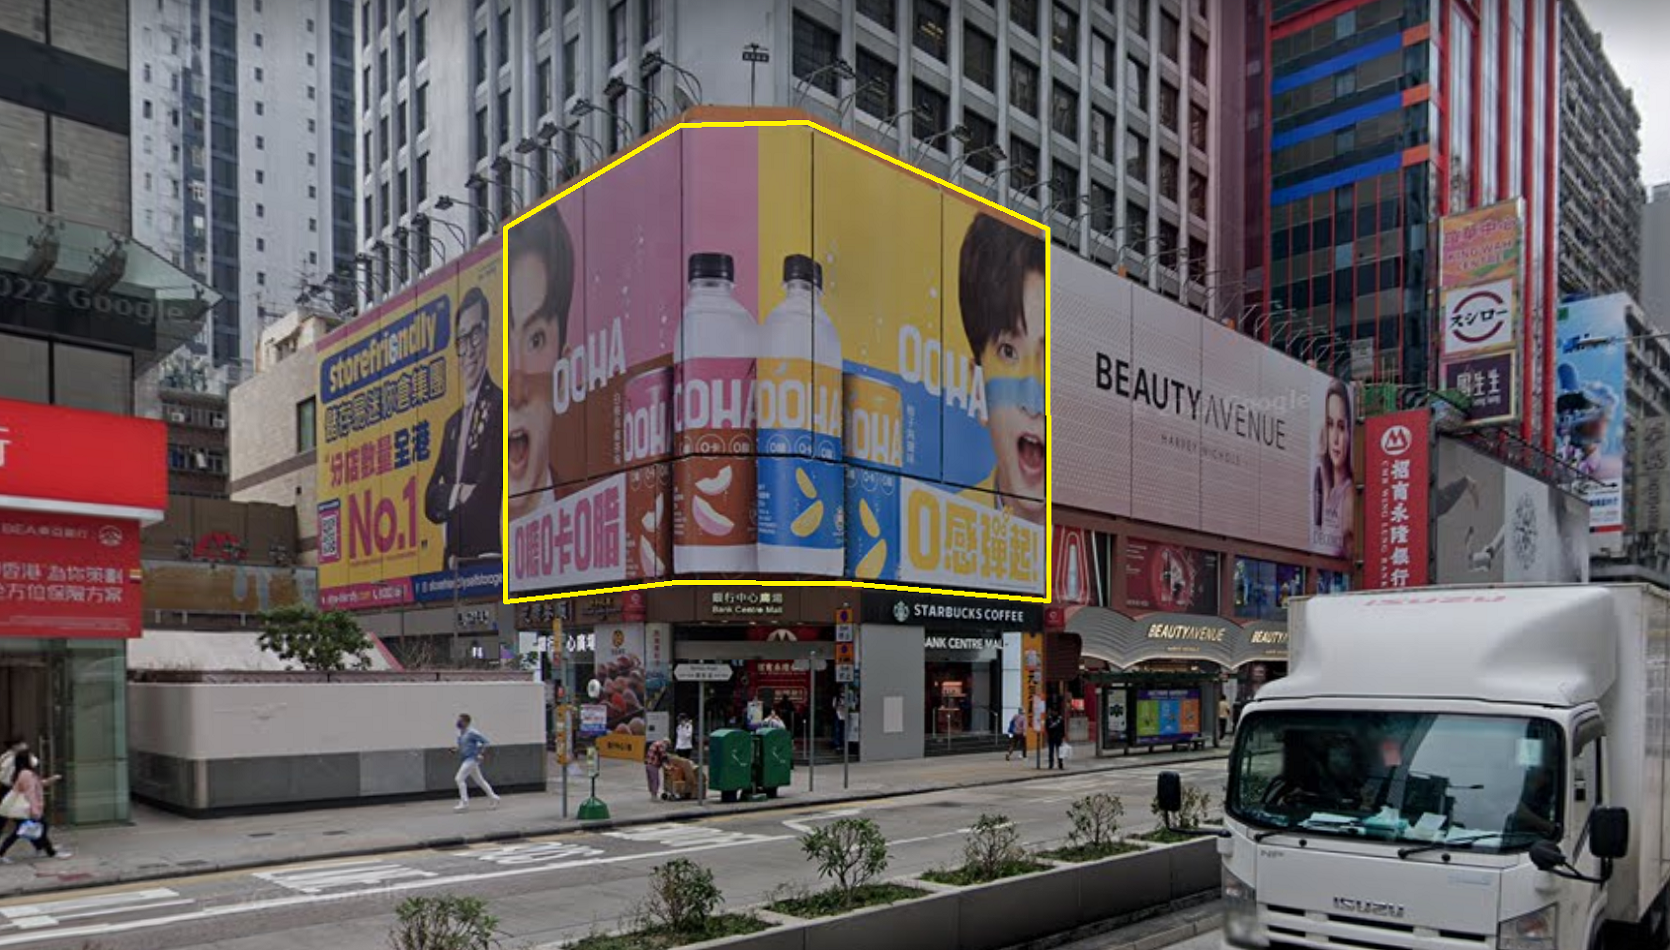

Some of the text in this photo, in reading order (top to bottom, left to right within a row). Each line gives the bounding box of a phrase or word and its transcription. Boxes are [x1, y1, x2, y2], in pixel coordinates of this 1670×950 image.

[1450, 307, 1508, 328] スシロー
[329, 311, 437, 394] storefriendly
[553, 317, 627, 415] OOHA
[900, 324, 988, 421] OOHA
[1390, 459, 1410, 587] 招商永隆銀行
[712, 592, 783, 604] 銀行中心廣場
[712, 605, 783, 614] Bank Centre Mall
[914, 603, 1024, 622] STARBUCKS COFFEE
[924, 636, 1007, 650] ANK CENTRE MAL
[1333, 896, 1404, 918] ISUZU
